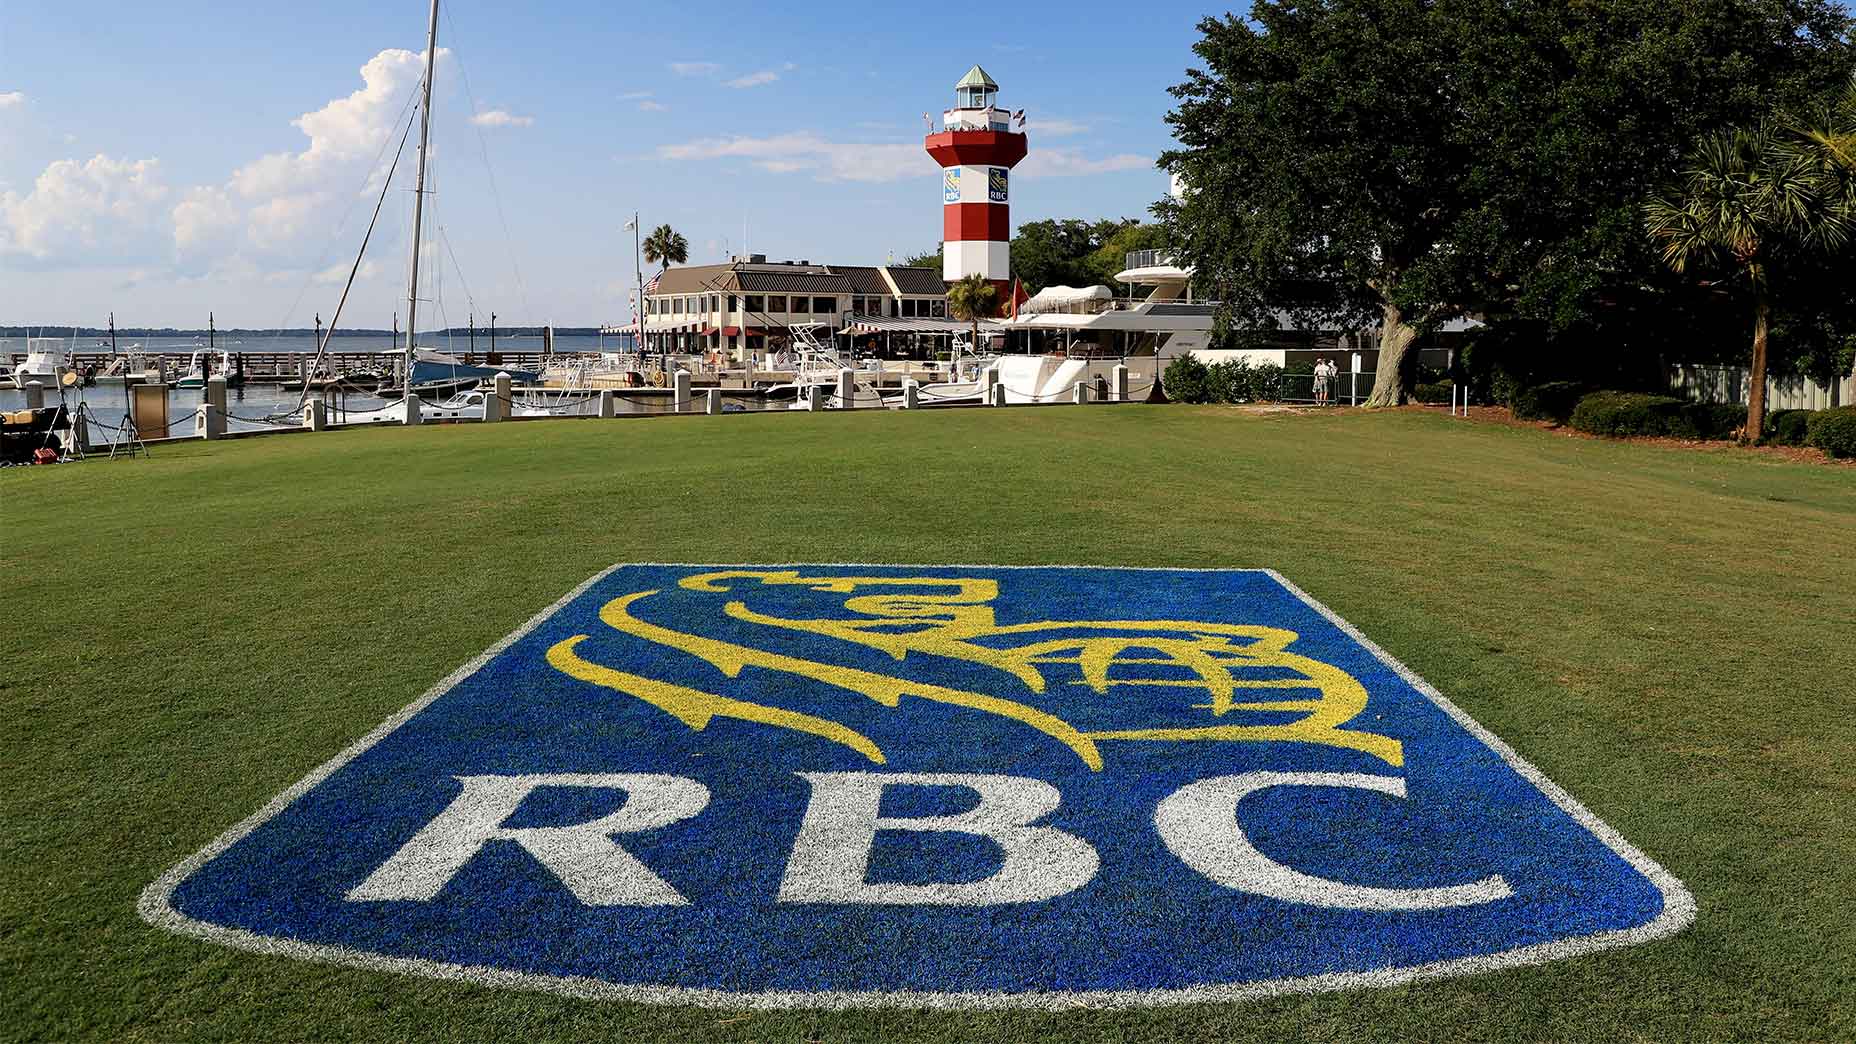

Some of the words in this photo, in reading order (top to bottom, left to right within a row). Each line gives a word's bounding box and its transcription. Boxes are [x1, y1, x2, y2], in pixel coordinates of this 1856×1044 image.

[945, 191, 960, 200] RBC
[990, 191, 1007, 200] RBC
[344, 770, 1515, 912] RBC
